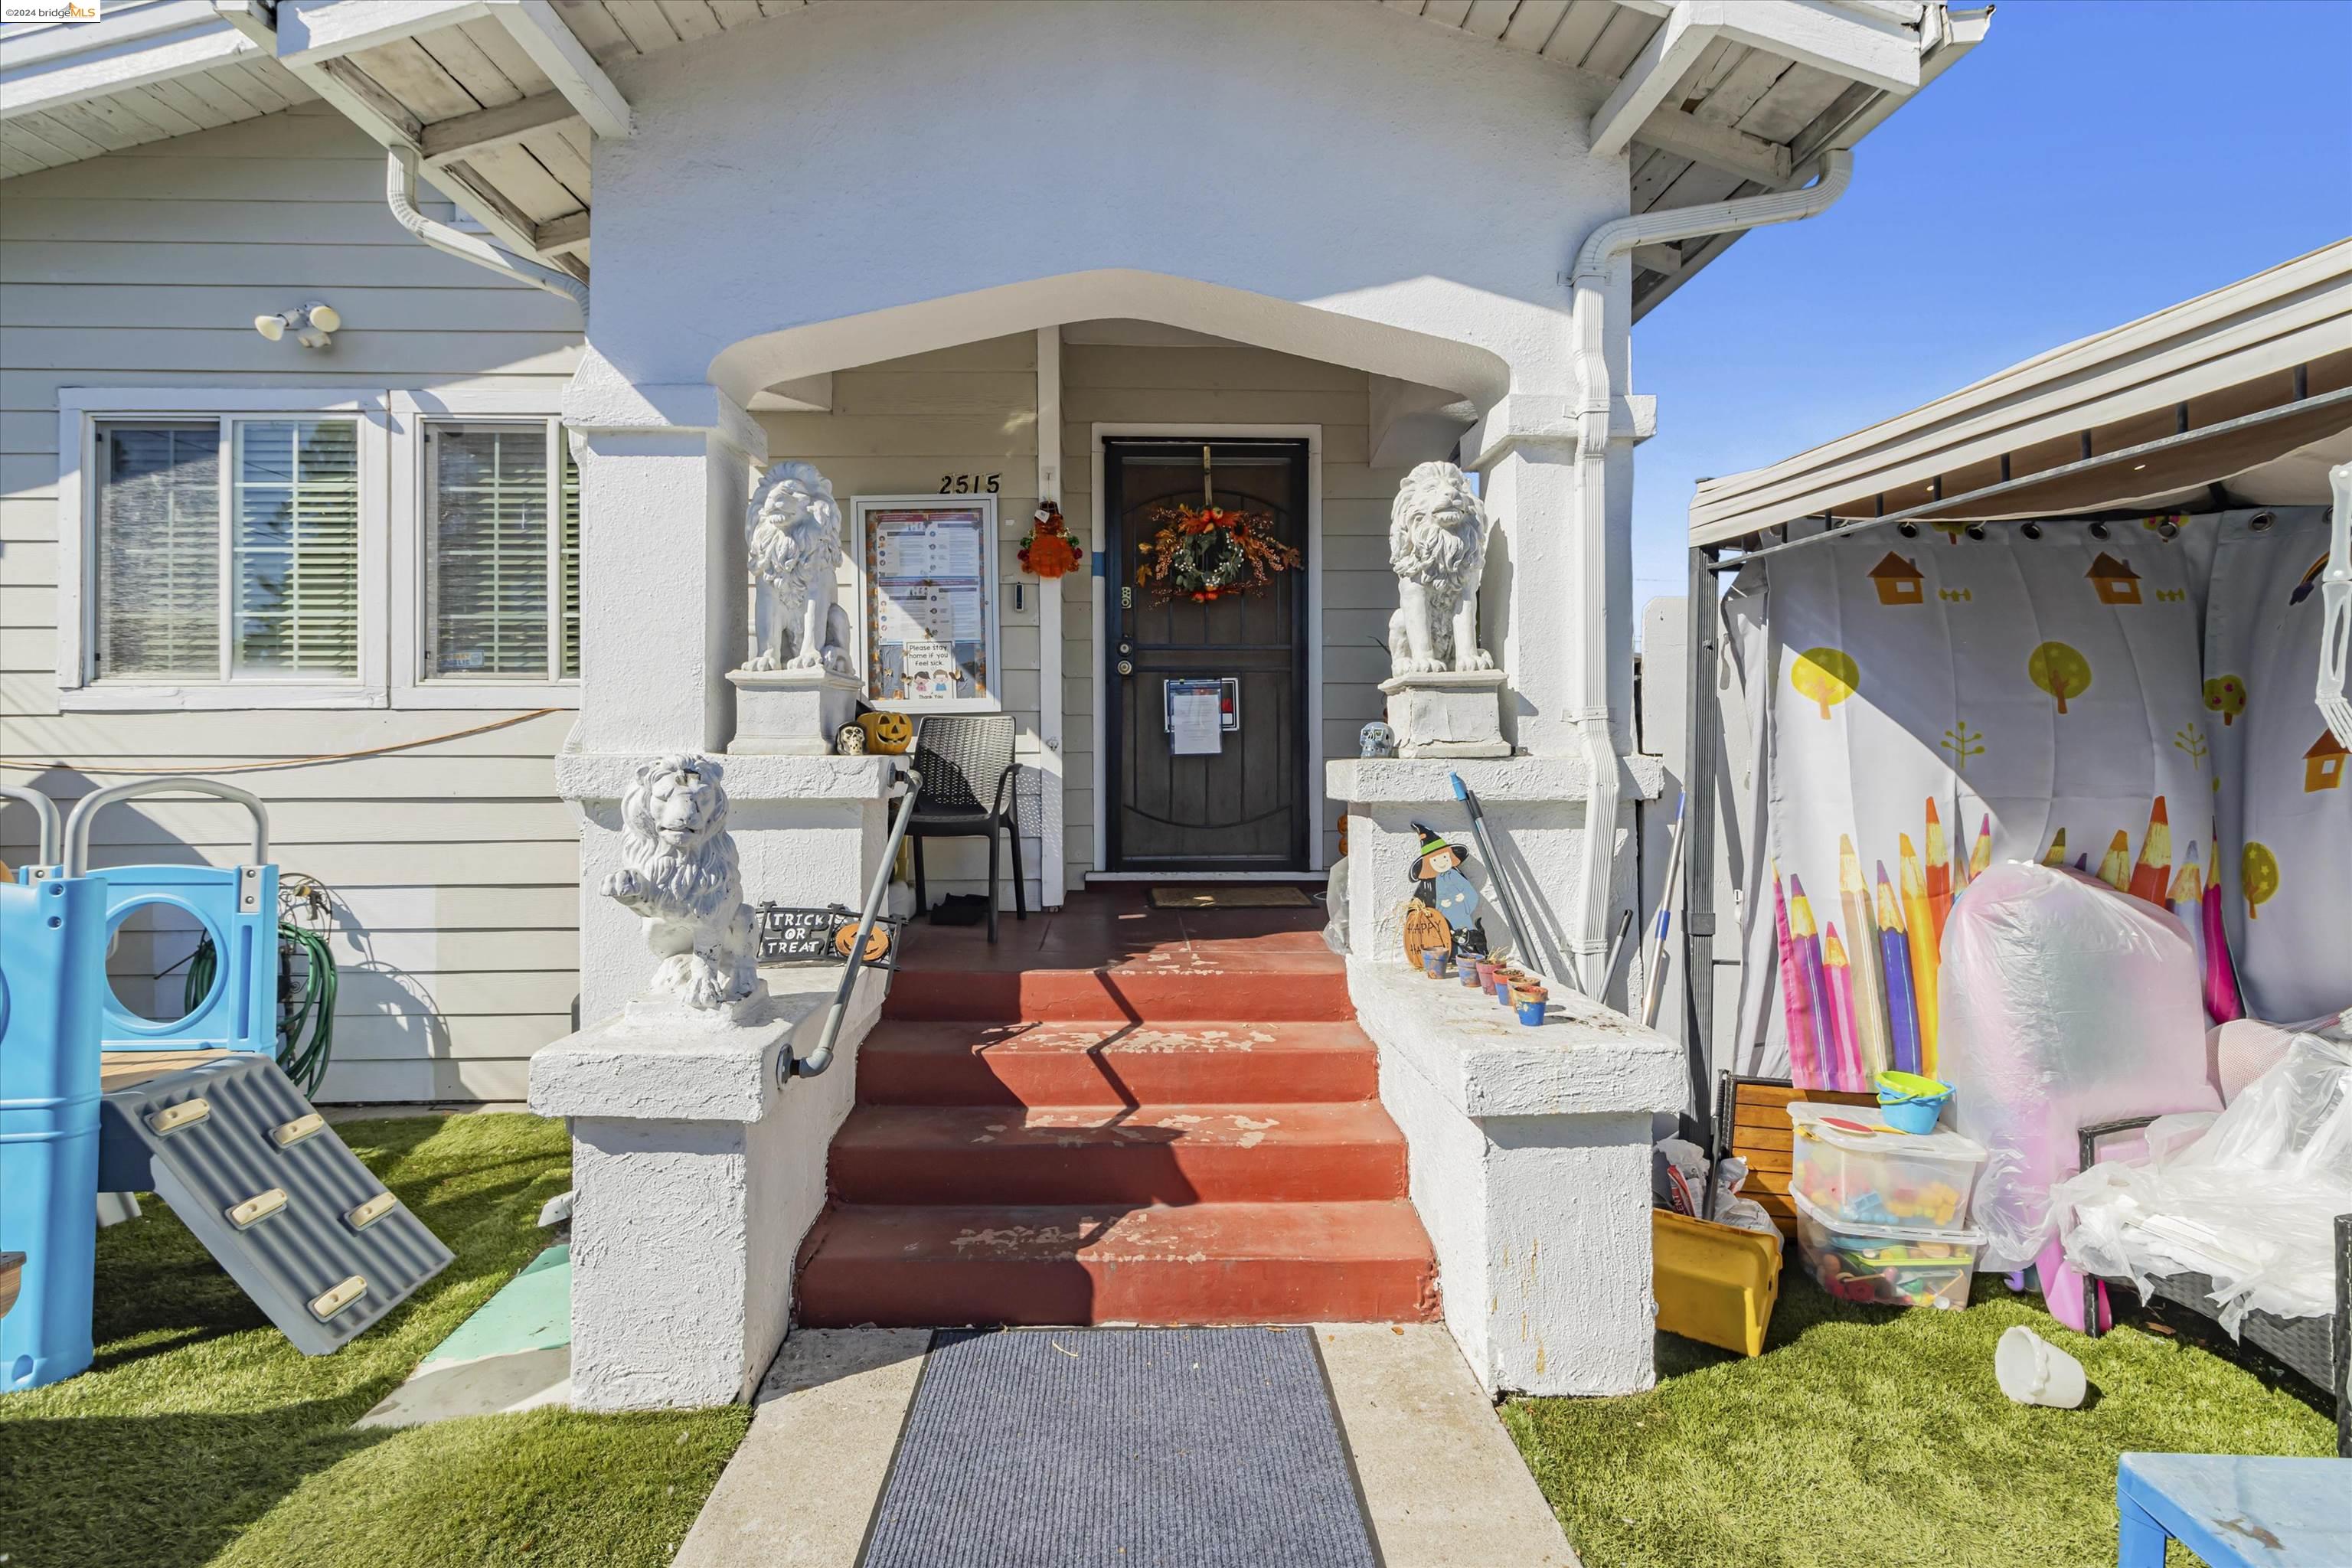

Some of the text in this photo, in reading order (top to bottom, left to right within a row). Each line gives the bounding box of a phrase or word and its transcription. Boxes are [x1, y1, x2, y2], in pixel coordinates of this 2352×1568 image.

[939, 474, 1000, 494] 2515
[773, 913, 825, 926] TRICK
[785, 927, 805, 939] OR
[1407, 920, 1441, 936] HAPPY
[767, 941, 819, 954] TREAT
